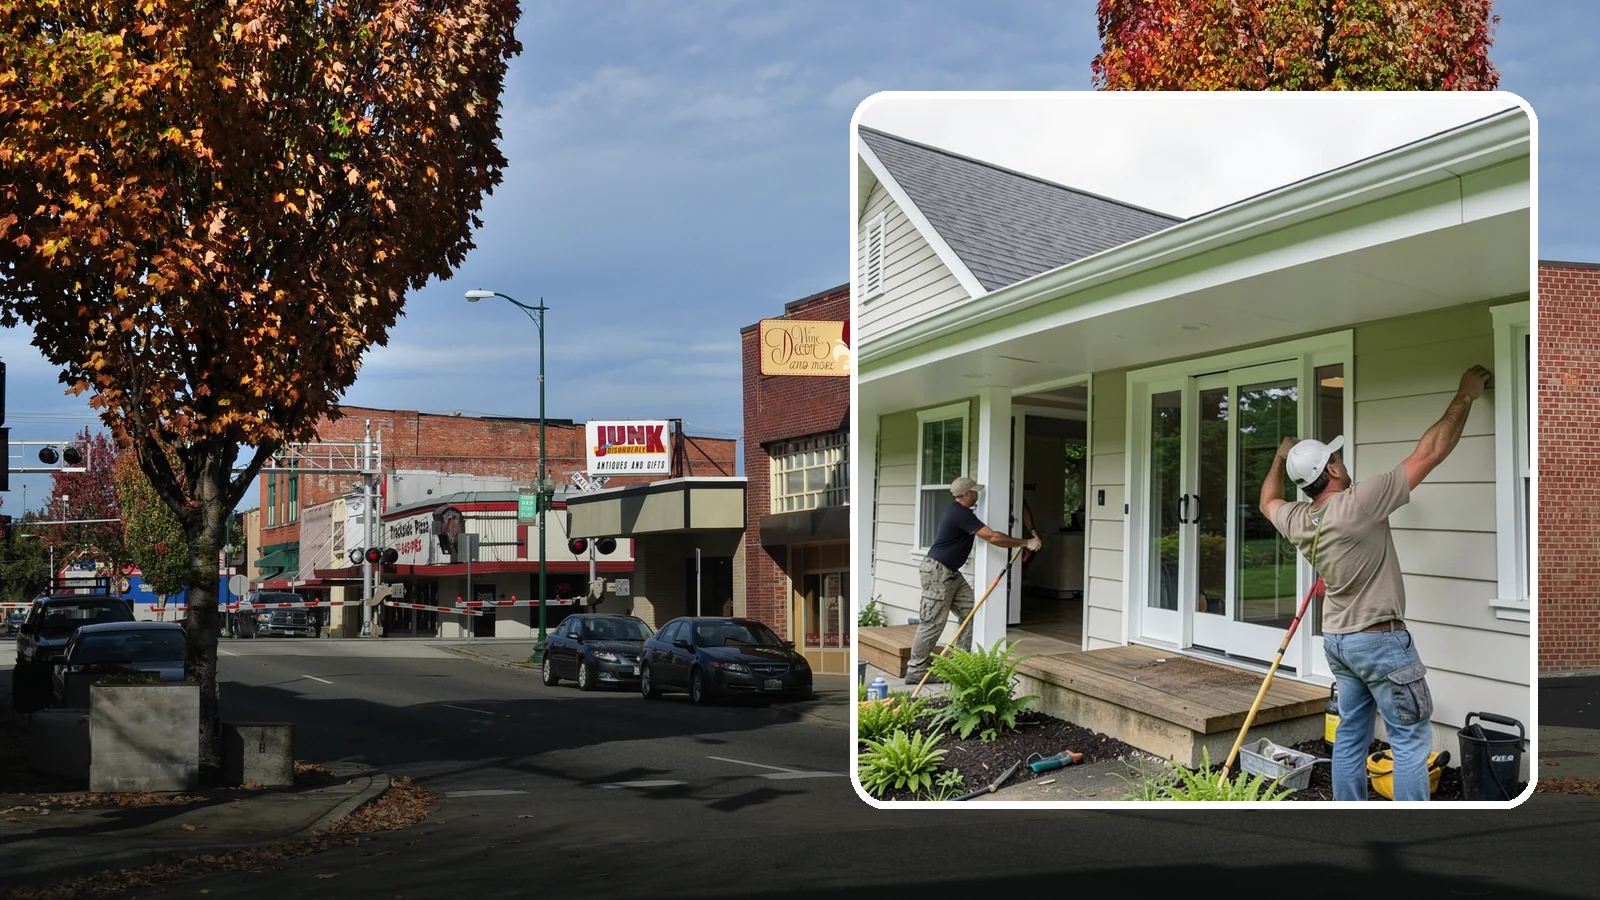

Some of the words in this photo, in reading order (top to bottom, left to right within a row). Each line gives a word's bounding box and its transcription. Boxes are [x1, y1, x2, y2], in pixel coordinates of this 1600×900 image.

[595, 425, 665, 457] JUNK
[607, 446, 646, 454] DISORDERLY
[597, 461, 628, 470] ANTIQUES
[631, 461, 644, 470] AND
[647, 460, 665, 469] GIFTS
[415, 519, 429, 534] Pizza
